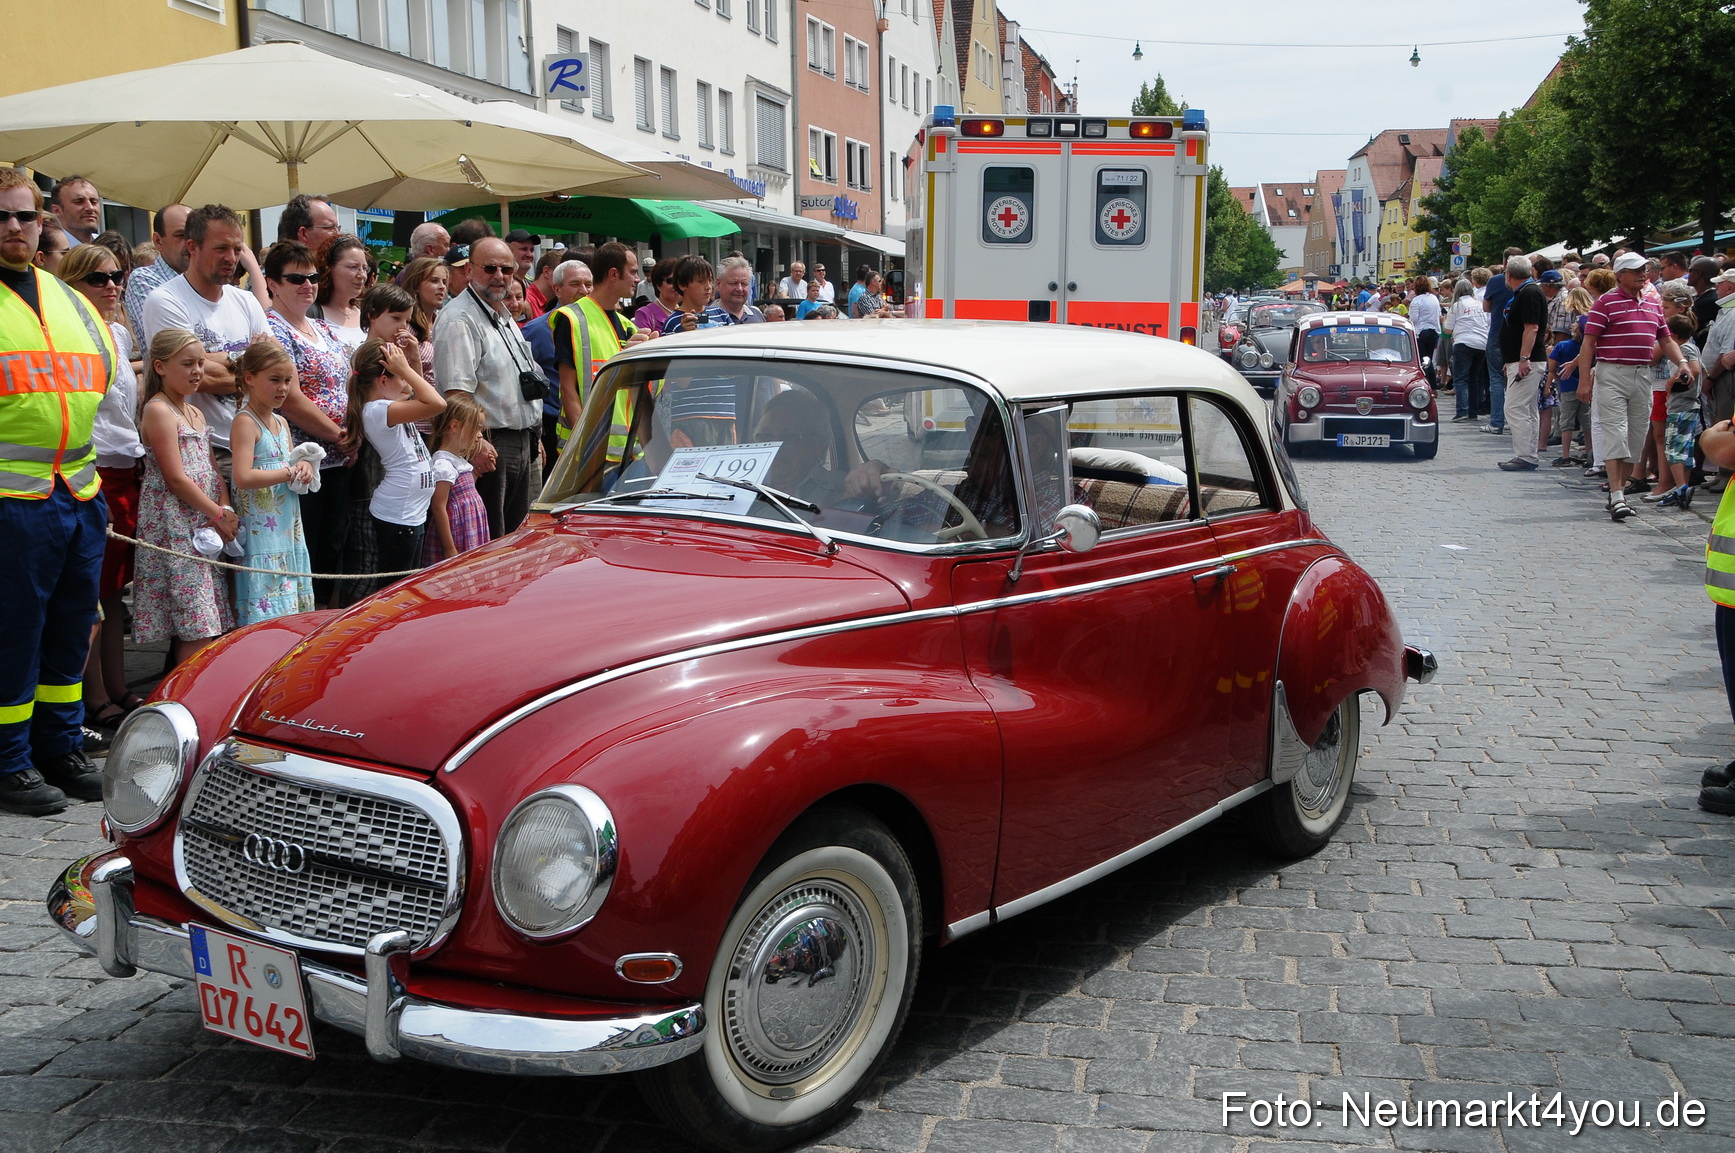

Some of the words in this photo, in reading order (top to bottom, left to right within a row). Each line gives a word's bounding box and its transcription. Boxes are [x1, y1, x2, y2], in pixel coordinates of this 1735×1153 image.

[495, 209, 593, 220] Lmmsbräu
[514, 203, 585, 211] Neumarkter
[991, 199, 1026, 216] BAYERISCHES
[1104, 201, 1139, 218] BAYERISCHES
[991, 217, 1006, 235] ROTES
[1008, 218, 1026, 235] KREUZ
[1103, 219, 1119, 237] ROTES
[1121, 220, 1139, 237] KREUZ
[0, 353, 93, 391] THW
[1343, 435, 1349, 446] R
[713, 458, 757, 479] 199
[199, 956, 207, 969] D
[227, 943, 252, 989] R
[200, 982, 309, 1051] 07642
